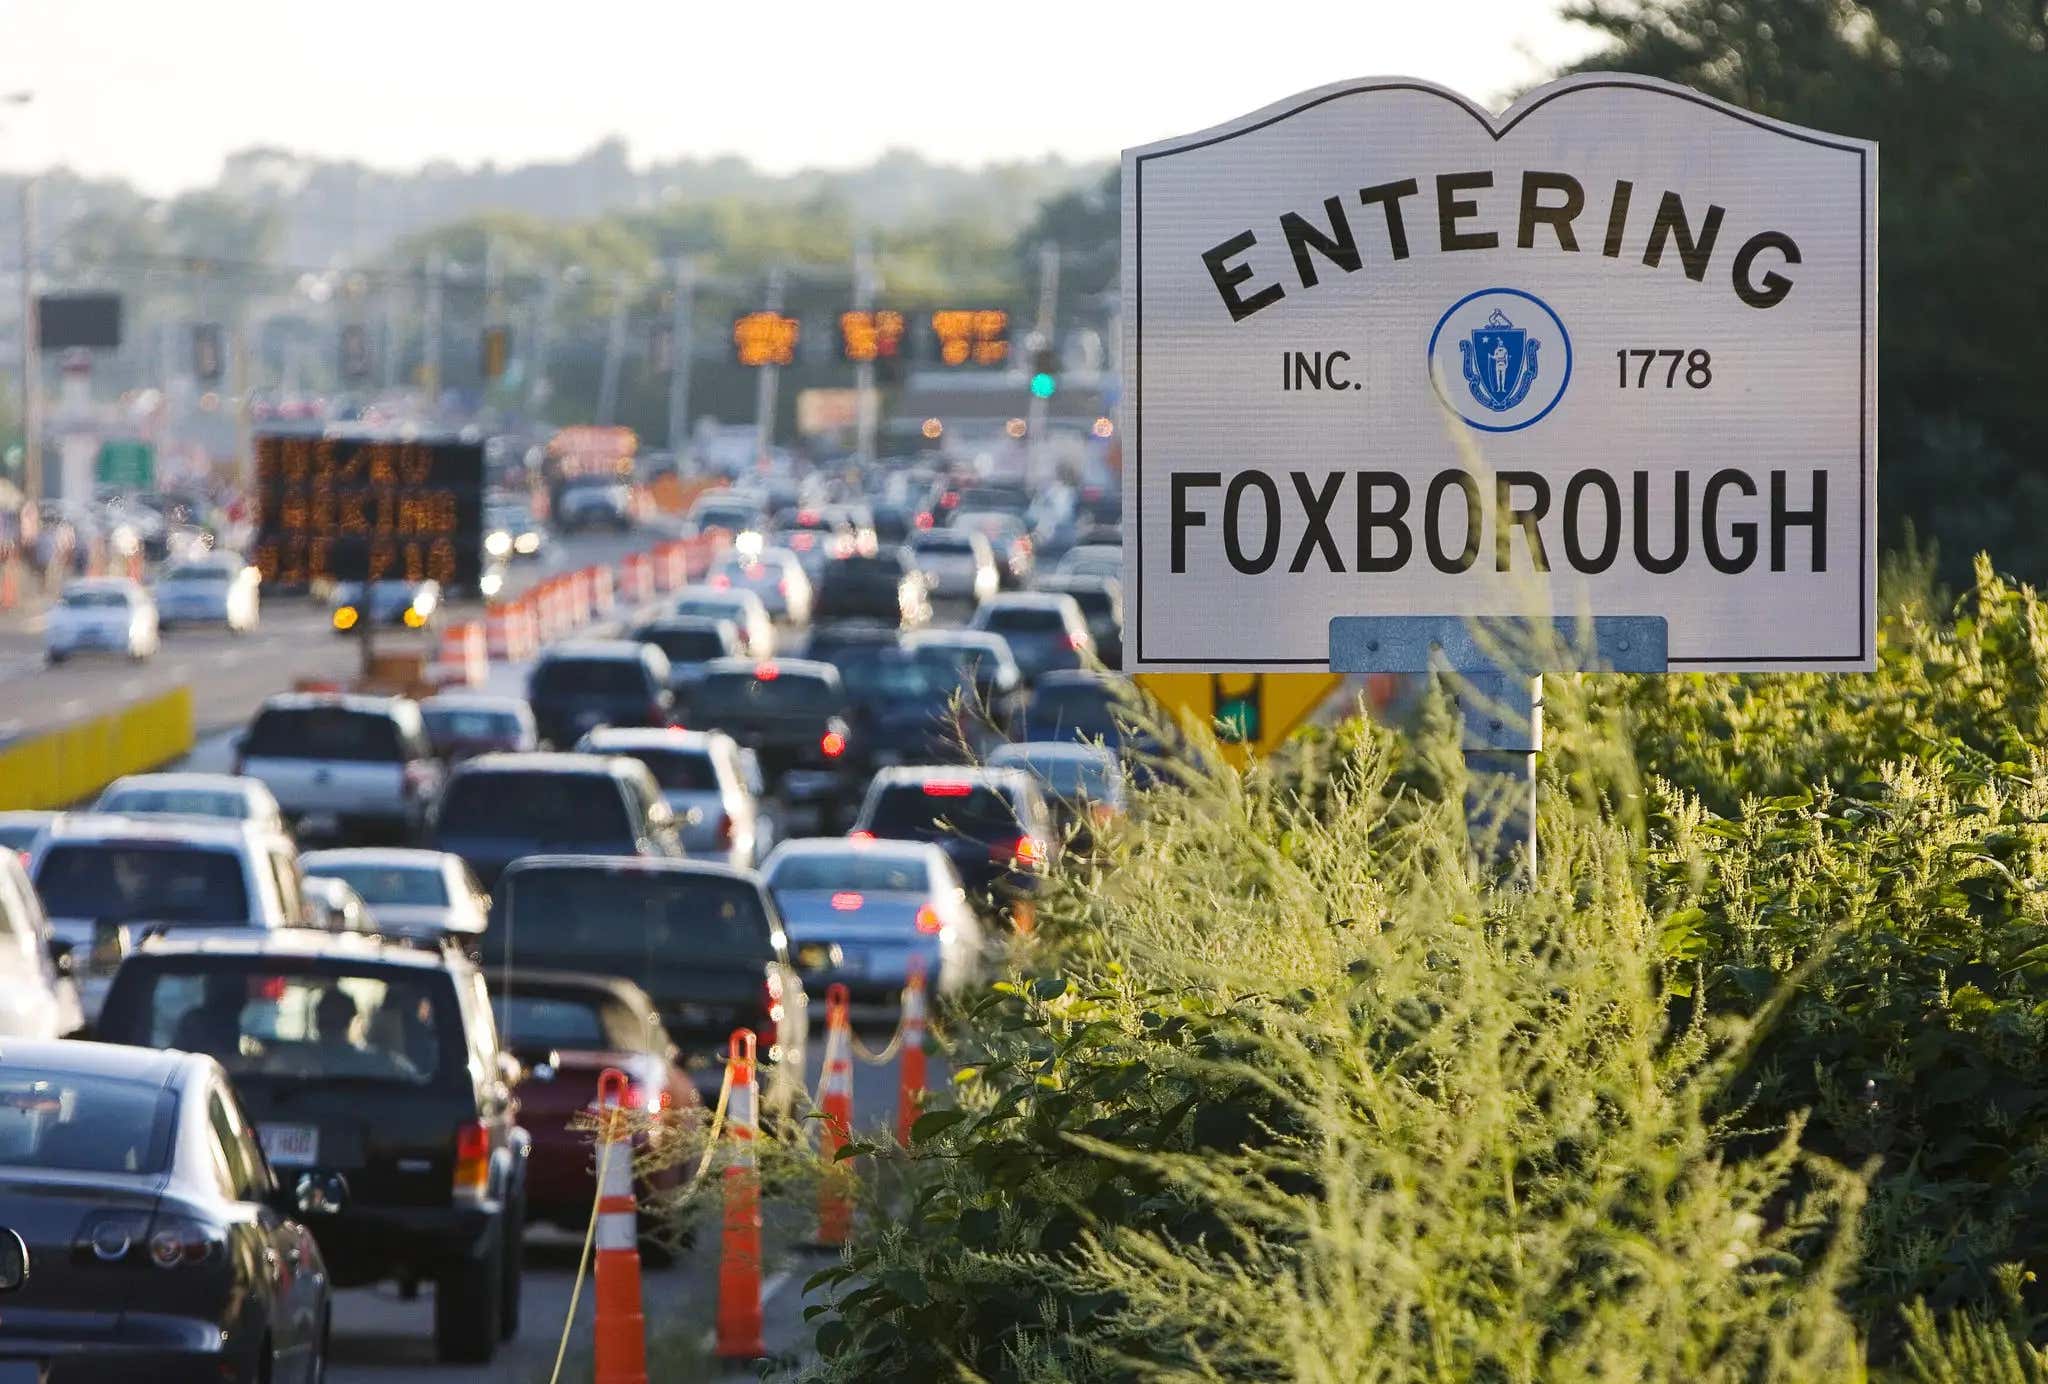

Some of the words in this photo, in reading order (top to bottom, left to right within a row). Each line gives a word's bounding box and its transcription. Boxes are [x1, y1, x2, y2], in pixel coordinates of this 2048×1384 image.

[1200, 170, 1802, 323] ENTERING
[1283, 350, 1363, 391] INC.
[1616, 349, 1713, 390] 1778
[1170, 468, 1828, 576] FOXBOROUGH
